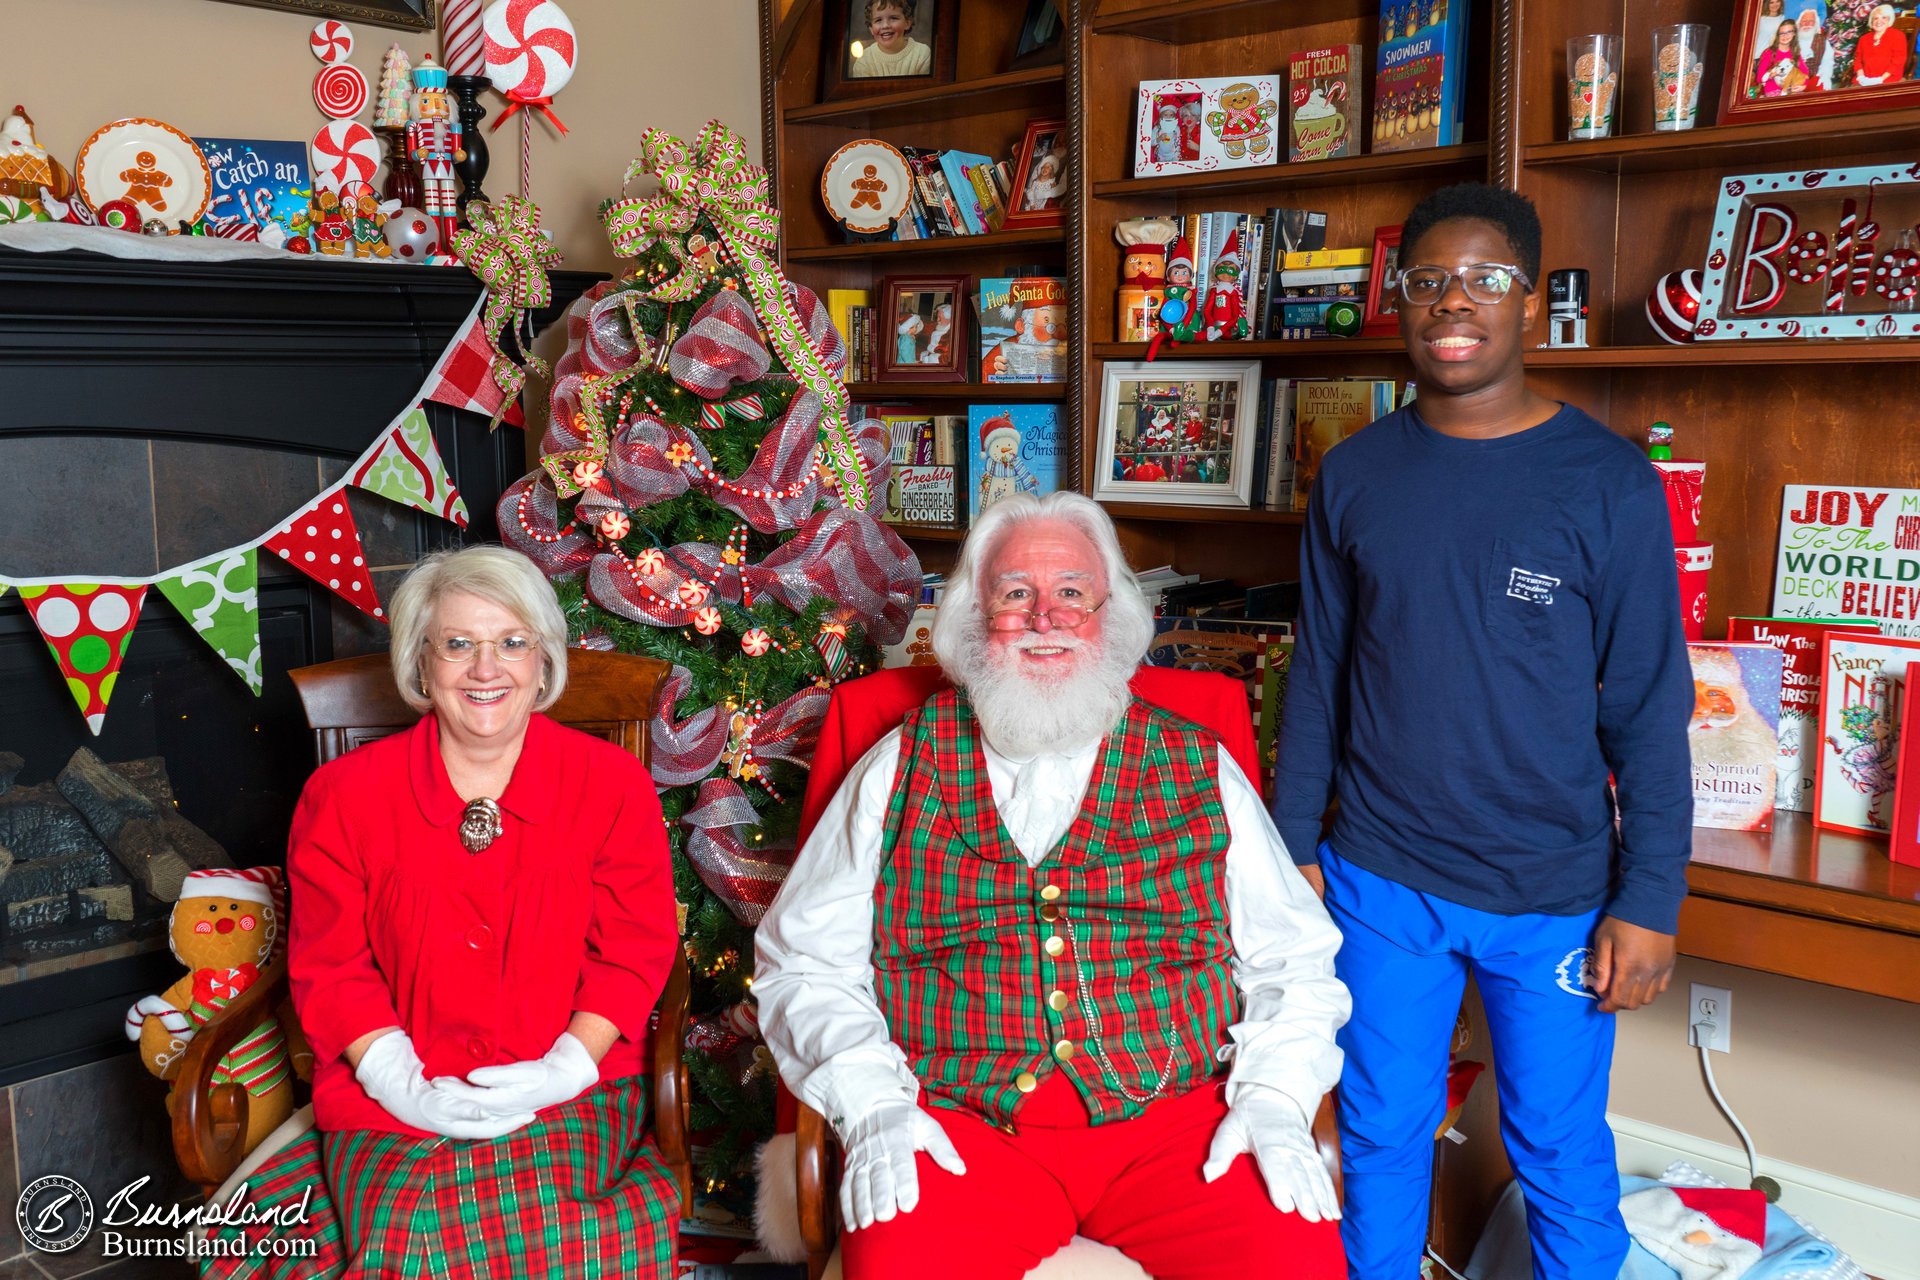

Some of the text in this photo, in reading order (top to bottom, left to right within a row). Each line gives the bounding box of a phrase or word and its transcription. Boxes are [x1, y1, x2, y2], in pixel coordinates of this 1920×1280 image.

[1306, 49, 1331, 59] FRESH
[1384, 39, 1432, 66] SNOWMEN
[1291, 54, 1347, 80] HOT COCOA
[1393, 63, 1428, 81] CHRISTMAS
[1296, 126, 1331, 152] Come
[1291, 145, 1321, 163] warm
[215, 151, 302, 190] Catch an
[1239, 220, 1247, 231] NO
[1212, 222, 1220, 257] PAINTED
[1262, 215, 1274, 270] DANIELLE STEEL
[1734, 196, 1920, 314] Belie
[986, 282, 1067, 310] How Santa Got
[1256, 293, 1266, 323] ROGUE
[1308, 386, 1339, 400] ROOM
[1045, 411, 1058, 426] A
[1305, 402, 1363, 415] LITTLE ONE
[1025, 425, 1068, 443] Magica
[1022, 441, 1067, 461] Christm
[900, 467, 953, 489] Freshly
[917, 482, 939, 491] BAKED
[901, 491, 954, 509] GINGERBREAD
[1790, 490, 1890, 527] JOY
[904, 508, 955, 522] COOKIES
[1785, 526, 1892, 552] To The
[1784, 551, 1920, 582] WORLD
[1783, 576, 1840, 600] DECK
[1796, 601, 1823, 620] the
[1791, 636, 1816, 650] The
[1831, 652, 1886, 674] Fancy
[1707, 761, 1744, 777] Spirit
[1746, 764, 1762, 776] of
[1694, 772, 1763, 796] istmas
